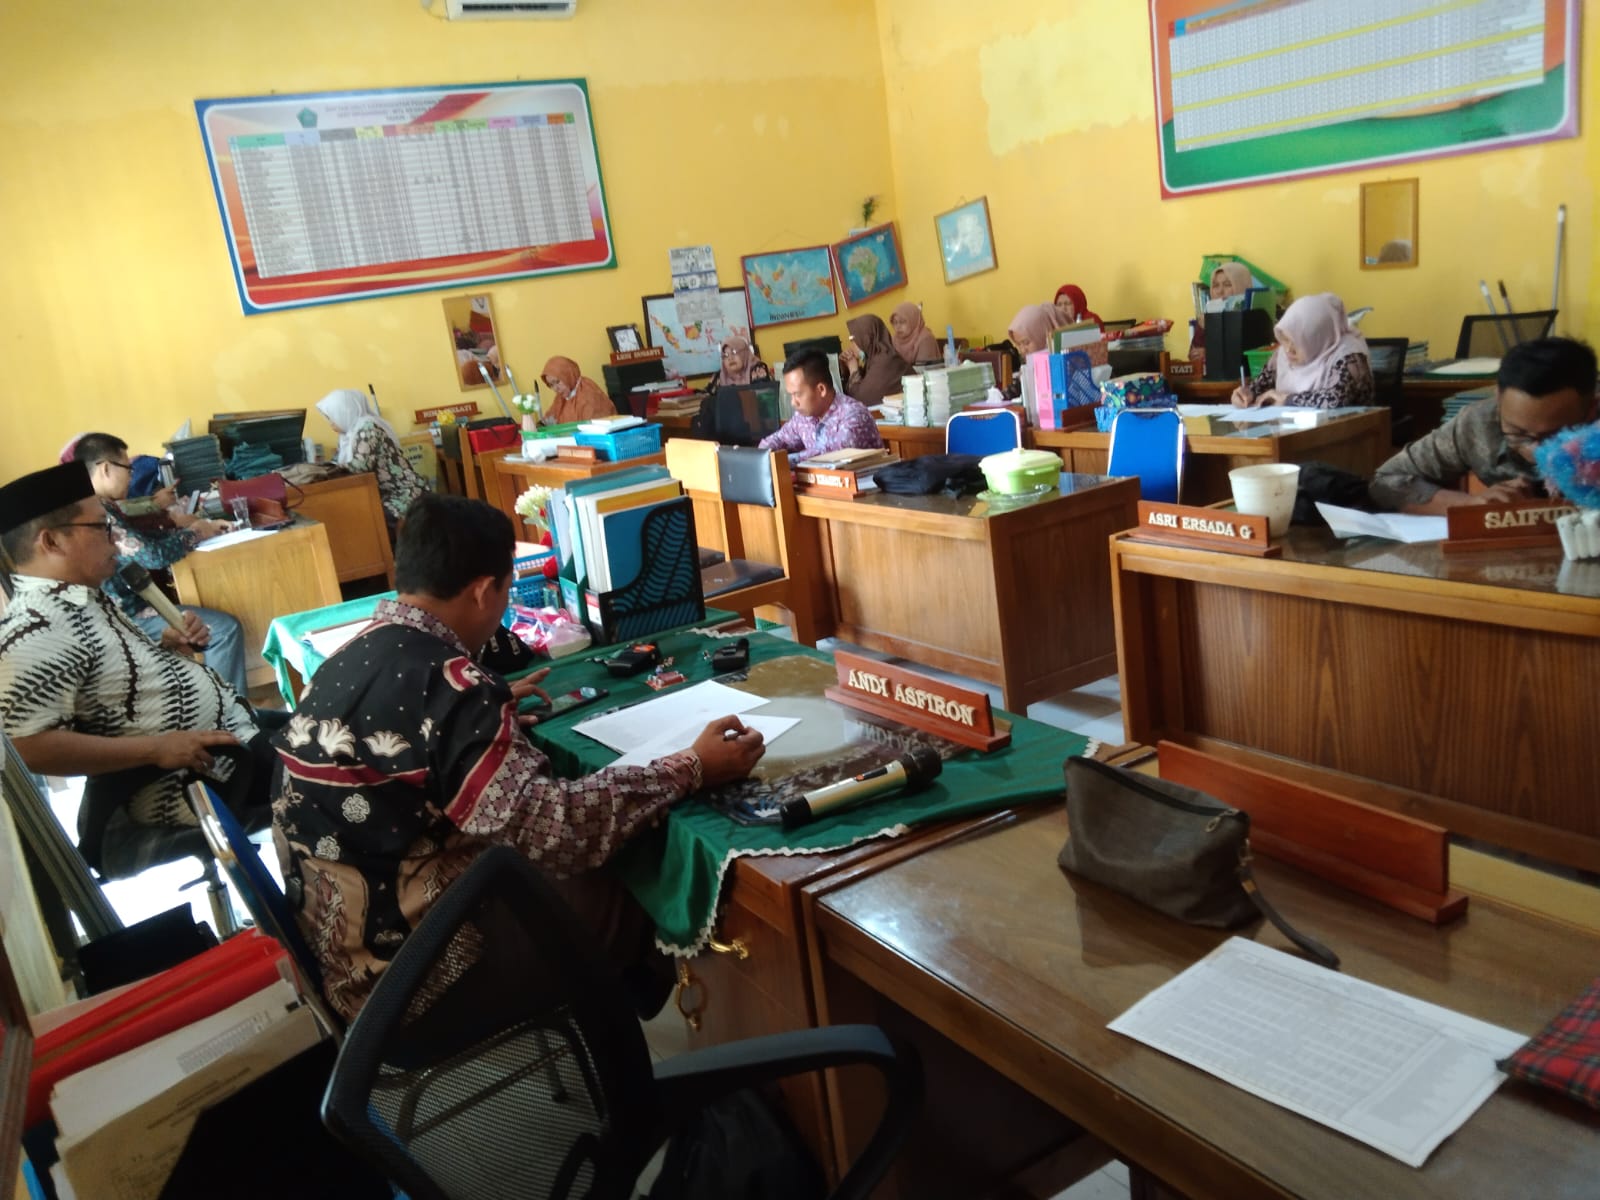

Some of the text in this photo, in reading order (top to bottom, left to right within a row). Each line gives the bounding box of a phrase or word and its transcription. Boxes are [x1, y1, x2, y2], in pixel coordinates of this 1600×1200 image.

[1148, 511, 1253, 540] ASRI ERSADA G
[847, 668, 889, 698] ANDI
